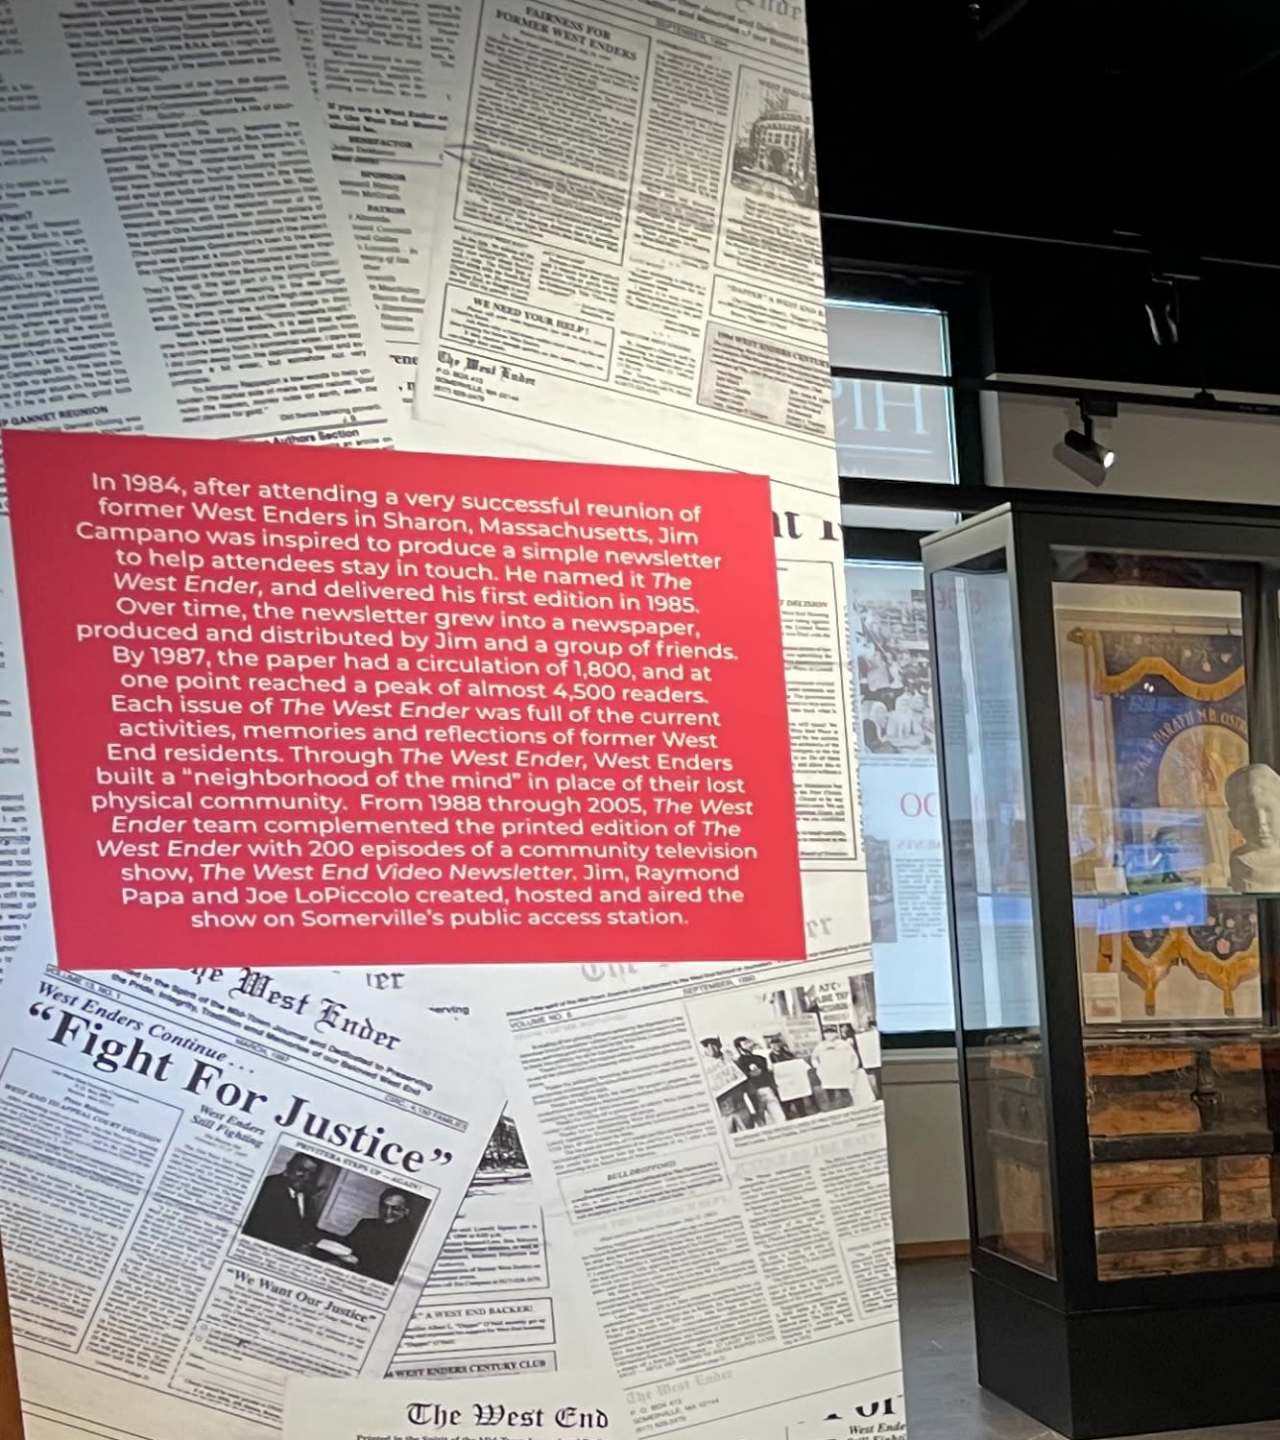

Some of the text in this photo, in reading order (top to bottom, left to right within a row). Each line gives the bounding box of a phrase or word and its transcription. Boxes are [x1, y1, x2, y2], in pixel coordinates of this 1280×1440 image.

[495, 9, 637, 61] FORMER WEST ENDERS
[525, 6, 610, 40] FAIRNESS FOR
[93, 473, 702, 523] In 1984, after attending a very successful reunion of
[99, 497, 699, 545] former West Enders in Sharon, Massachusetts, Jim
[76, 522, 721, 569] Campano was inspired to produce a simple newsletter
[116, 548, 692, 591] to help attendees stay in touch. He named it The
[114, 573, 700, 613] West Ender, and delivered his first edition in 1985.
[116, 597, 700, 639] Over time, the newsletter grew into a newspaper,
[38, 980, 227, 1061] West Enders Continue
[235, 968, 400, 1050] West Ender
[28, 1001, 173, 1081] “Fight
[181, 1058, 267, 1113] For
[274, 1095, 452, 1172] Justice”
[226, 1267, 378, 1324] “We Want Our Justice”
[406, 1402, 608, 1428] The West End
